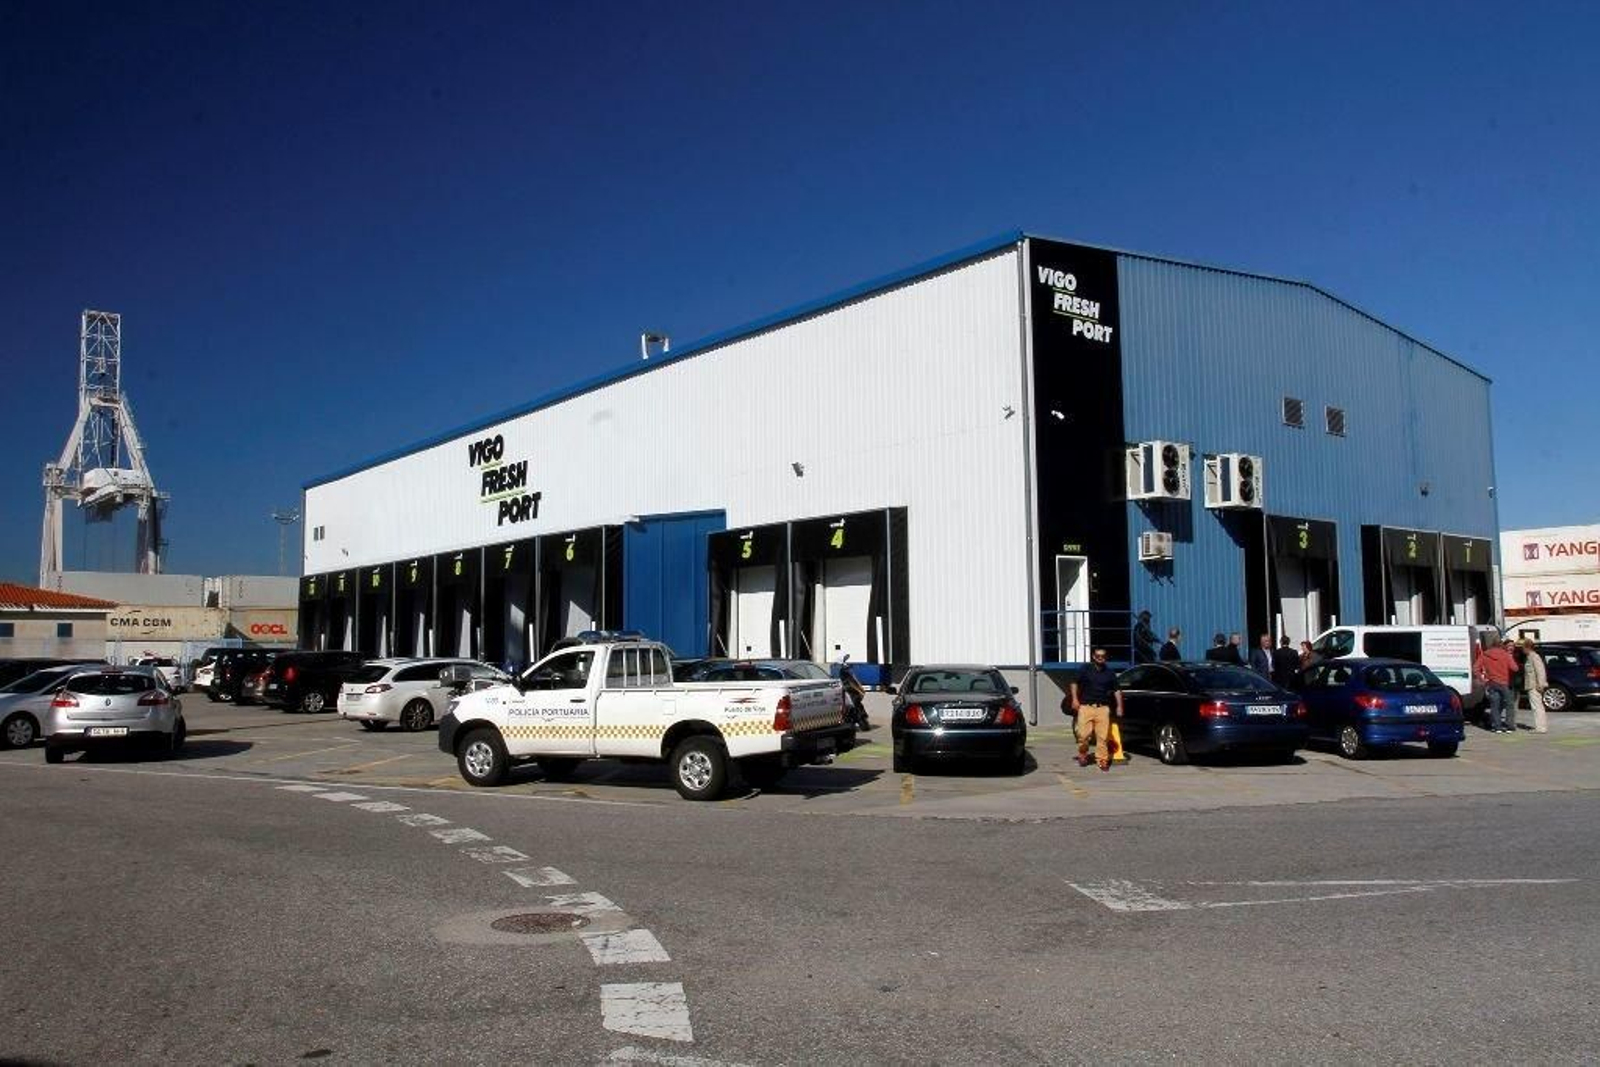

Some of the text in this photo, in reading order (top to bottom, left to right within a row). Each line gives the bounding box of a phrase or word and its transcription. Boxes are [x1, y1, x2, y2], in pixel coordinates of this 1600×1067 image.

[1037, 265, 1077, 291] VIGO
[1054, 292, 1100, 319] FRESH
[1072, 319, 1113, 343] PORT
[468, 434, 504, 468] VIGO
[481, 460, 528, 497] FRESH
[497, 491, 542, 526] PORT
[831, 528, 844, 549] 4
[1299, 531, 1308, 549] 3
[566, 543, 575, 561] 6
[741, 541, 752, 559] 5
[1408, 541, 1417, 558] 2
[1545, 541, 1598, 557] YANG
[455, 560, 462, 576] 8
[504, 552, 513, 569] 7
[1547, 589, 1600, 605] YANG
[110, 617, 172, 627] CMA CGM
[250, 623, 288, 635] OOCL
[541, 708, 590, 716] PORTUARIA
